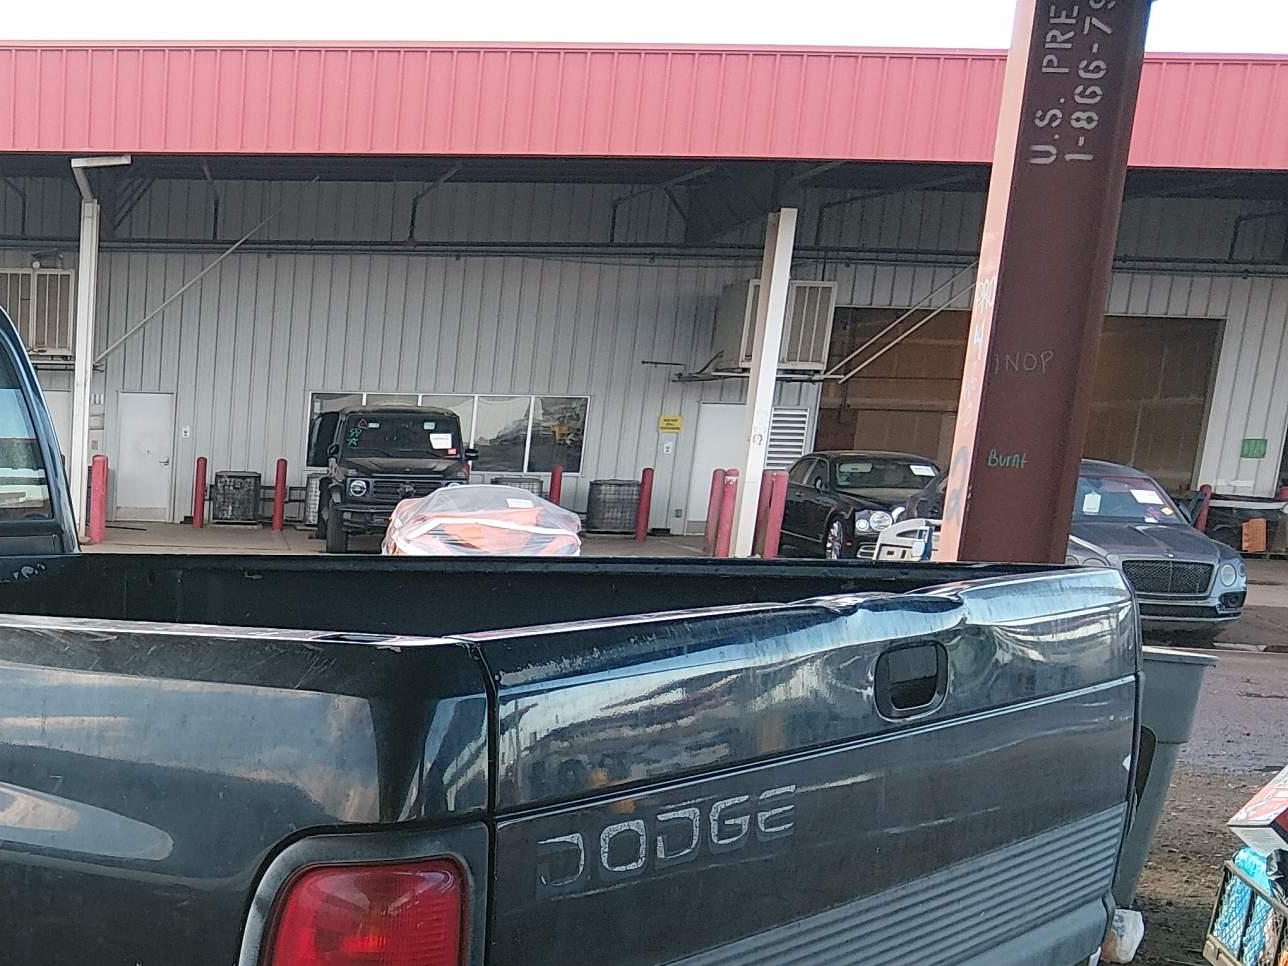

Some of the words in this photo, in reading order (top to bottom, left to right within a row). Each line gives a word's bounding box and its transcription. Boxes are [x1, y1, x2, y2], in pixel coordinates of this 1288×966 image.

[1029, 97, 1065, 165] U.S.
[987, 448, 1029, 469] Burnt
[536, 783, 797, 889] DODGE
